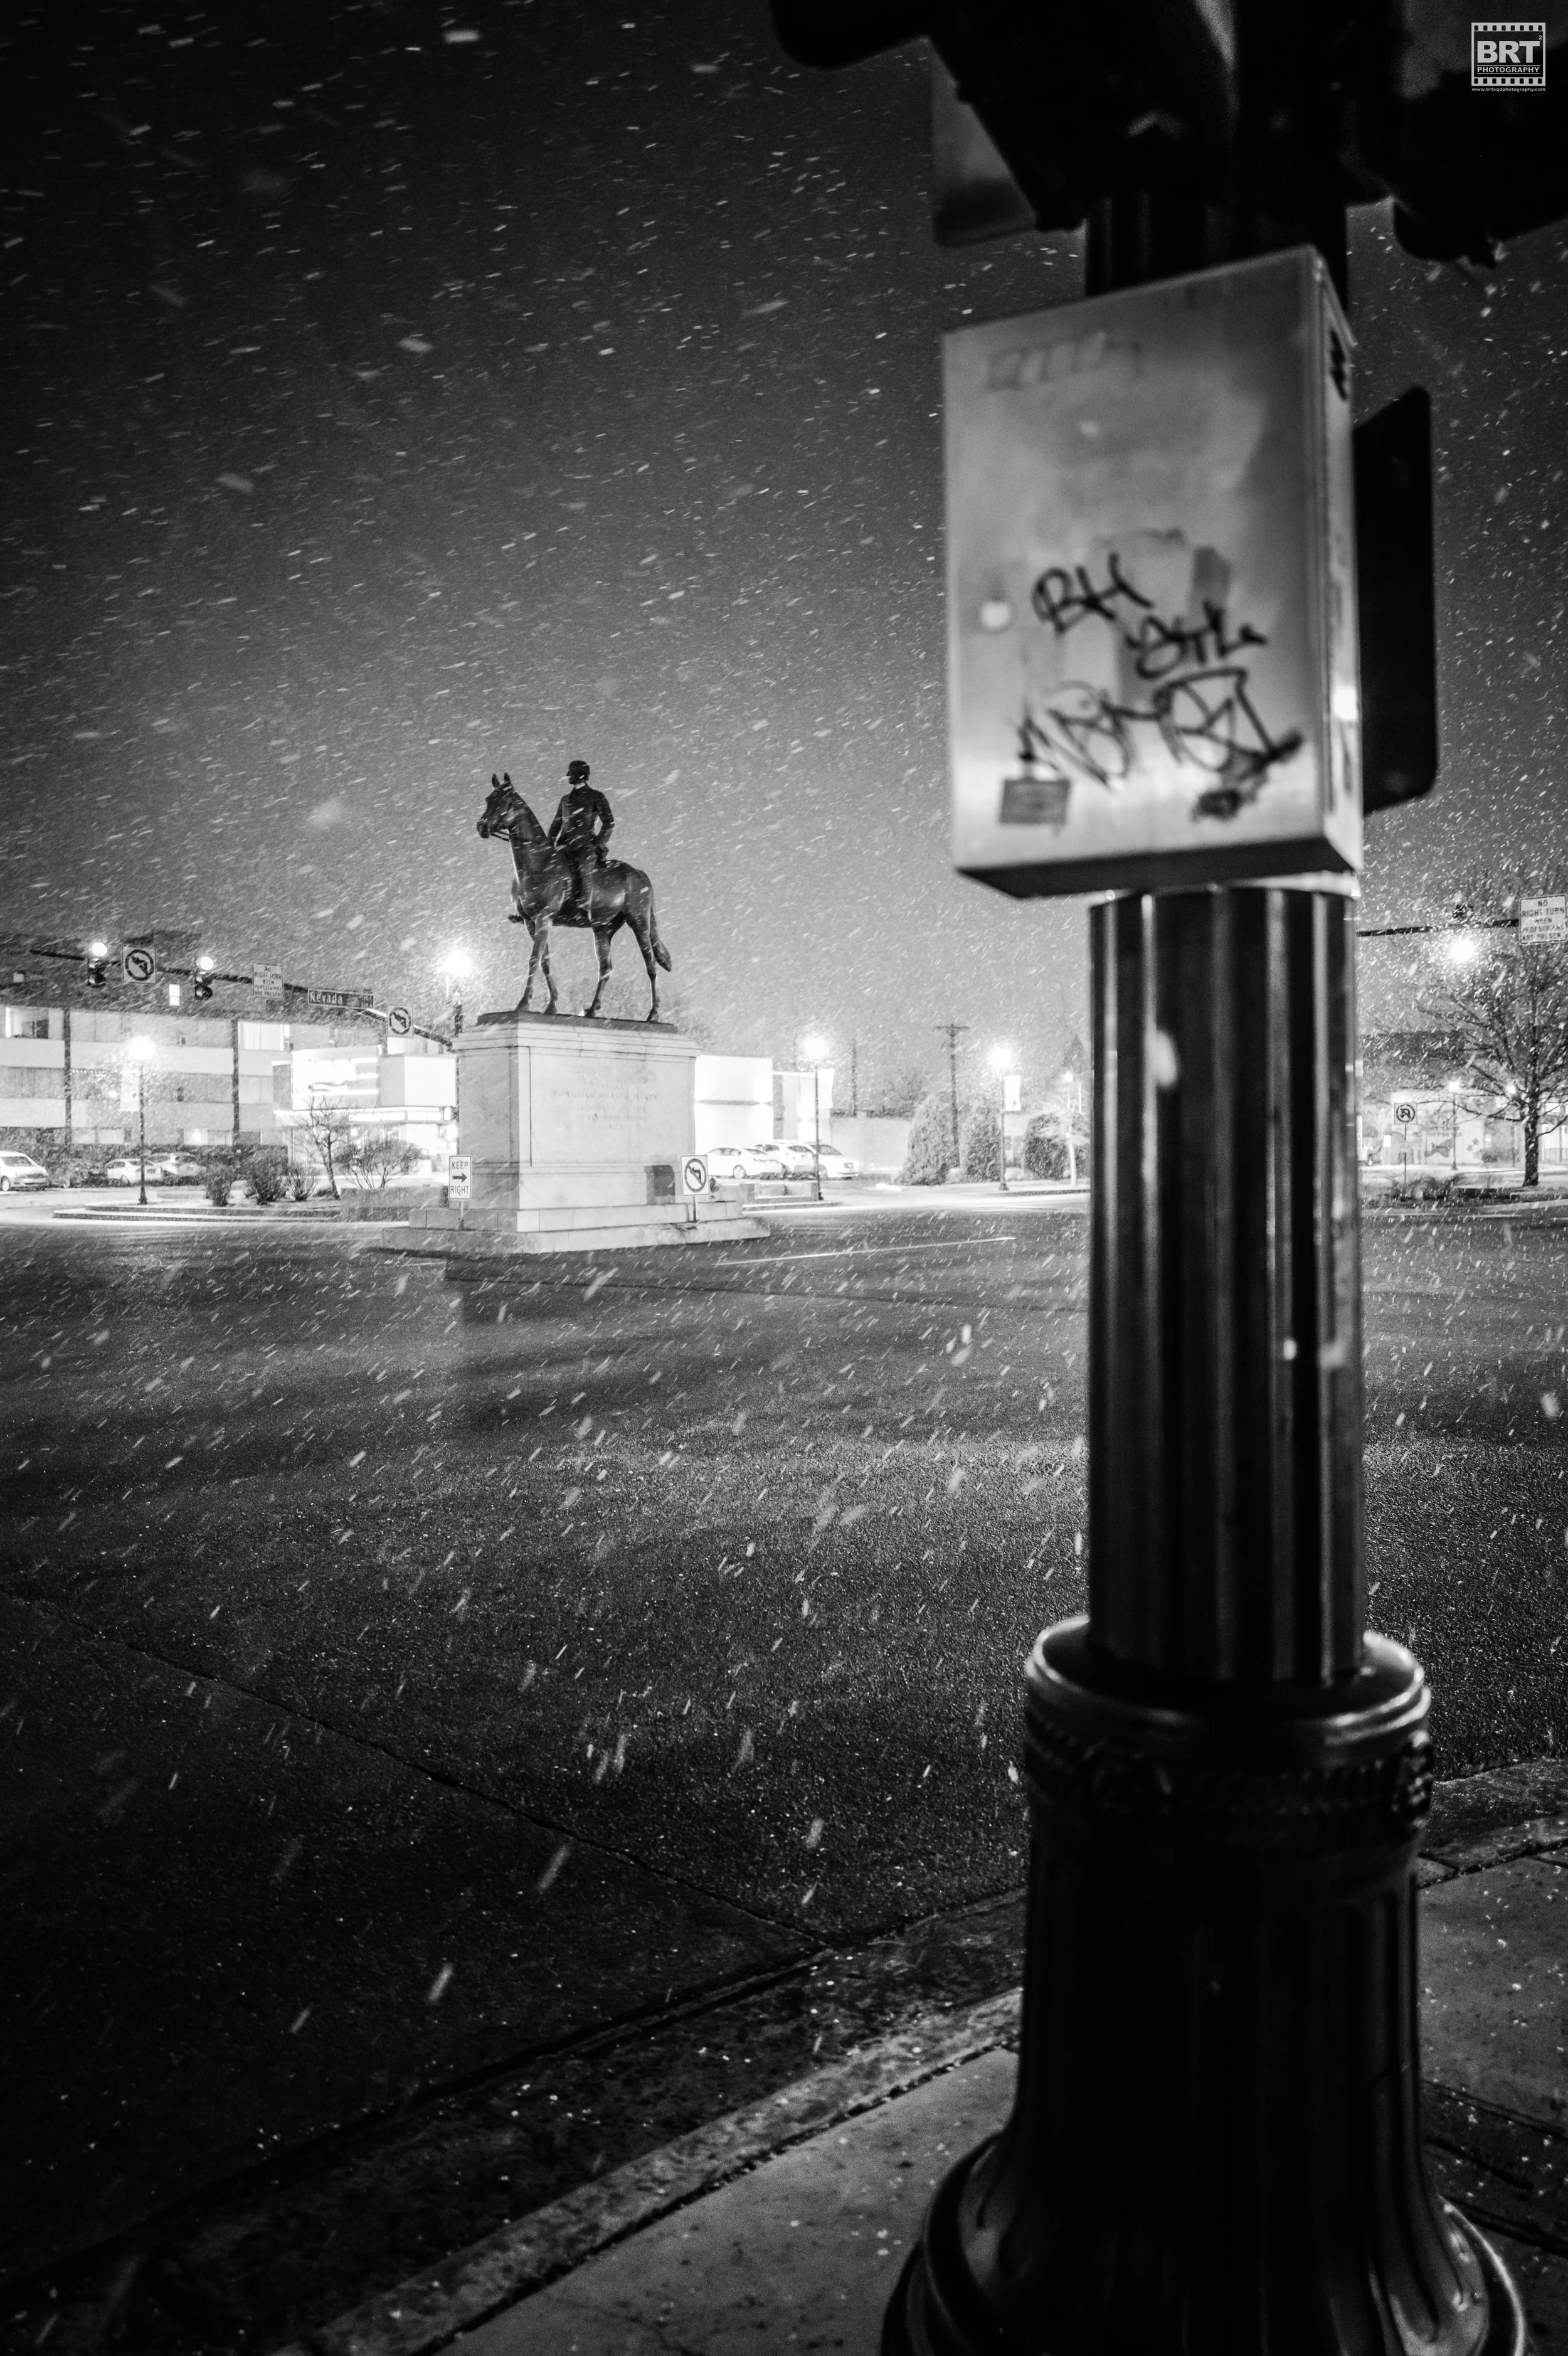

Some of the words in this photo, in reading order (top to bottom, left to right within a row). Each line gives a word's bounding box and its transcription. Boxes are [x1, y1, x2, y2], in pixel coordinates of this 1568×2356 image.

[1522, 908, 1542, 917] RIGHT
[1545, 906, 1565, 915] TURN
[310, 991, 343, 1004] Nevada
[452, 1161, 469, 1170] KEEP
[450, 1185, 469, 1194] RIGHT
